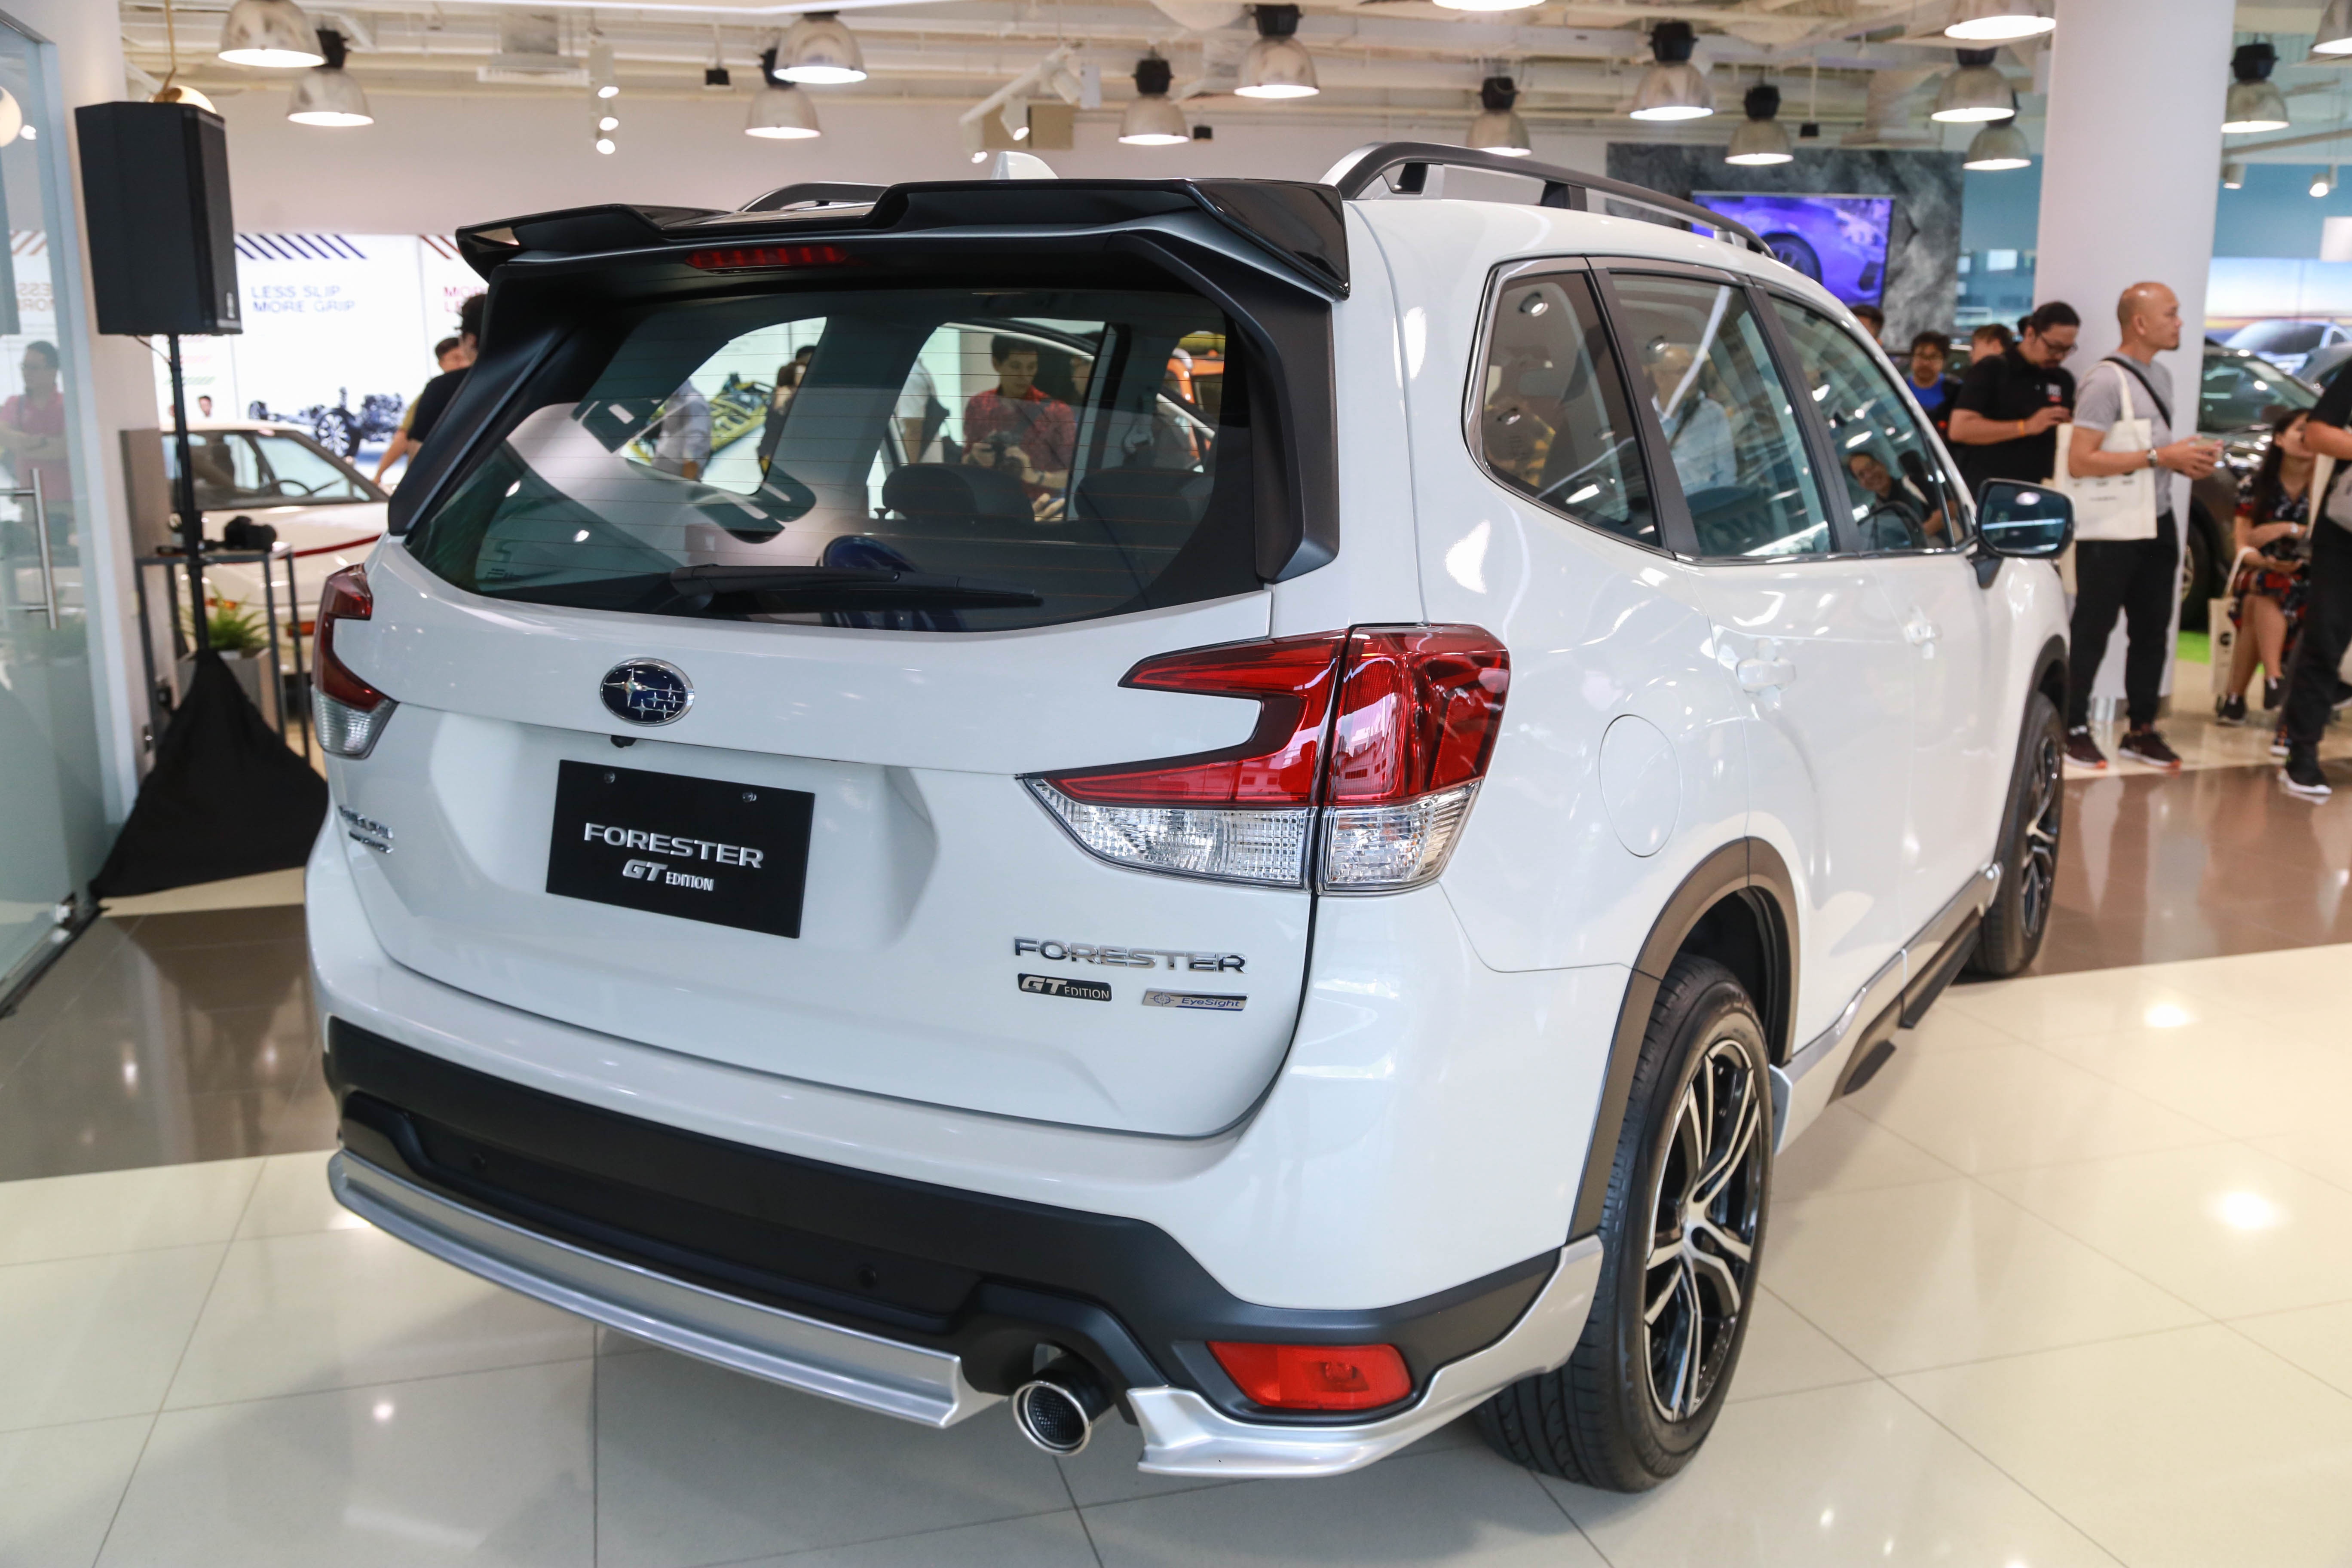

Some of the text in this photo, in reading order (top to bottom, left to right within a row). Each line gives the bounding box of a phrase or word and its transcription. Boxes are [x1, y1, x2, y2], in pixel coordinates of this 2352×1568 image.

[251, 286, 340, 297] LESS SLIP
[253, 300, 355, 313] MORE GRIP
[584, 823, 763, 868] FORESTER
[622, 859, 714, 891] GT EDITION
[1014, 936, 1248, 974] FORESTER
[1021, 976, 1109, 999] GT EDITION
[1181, 996, 1240, 1008] EyeSight
